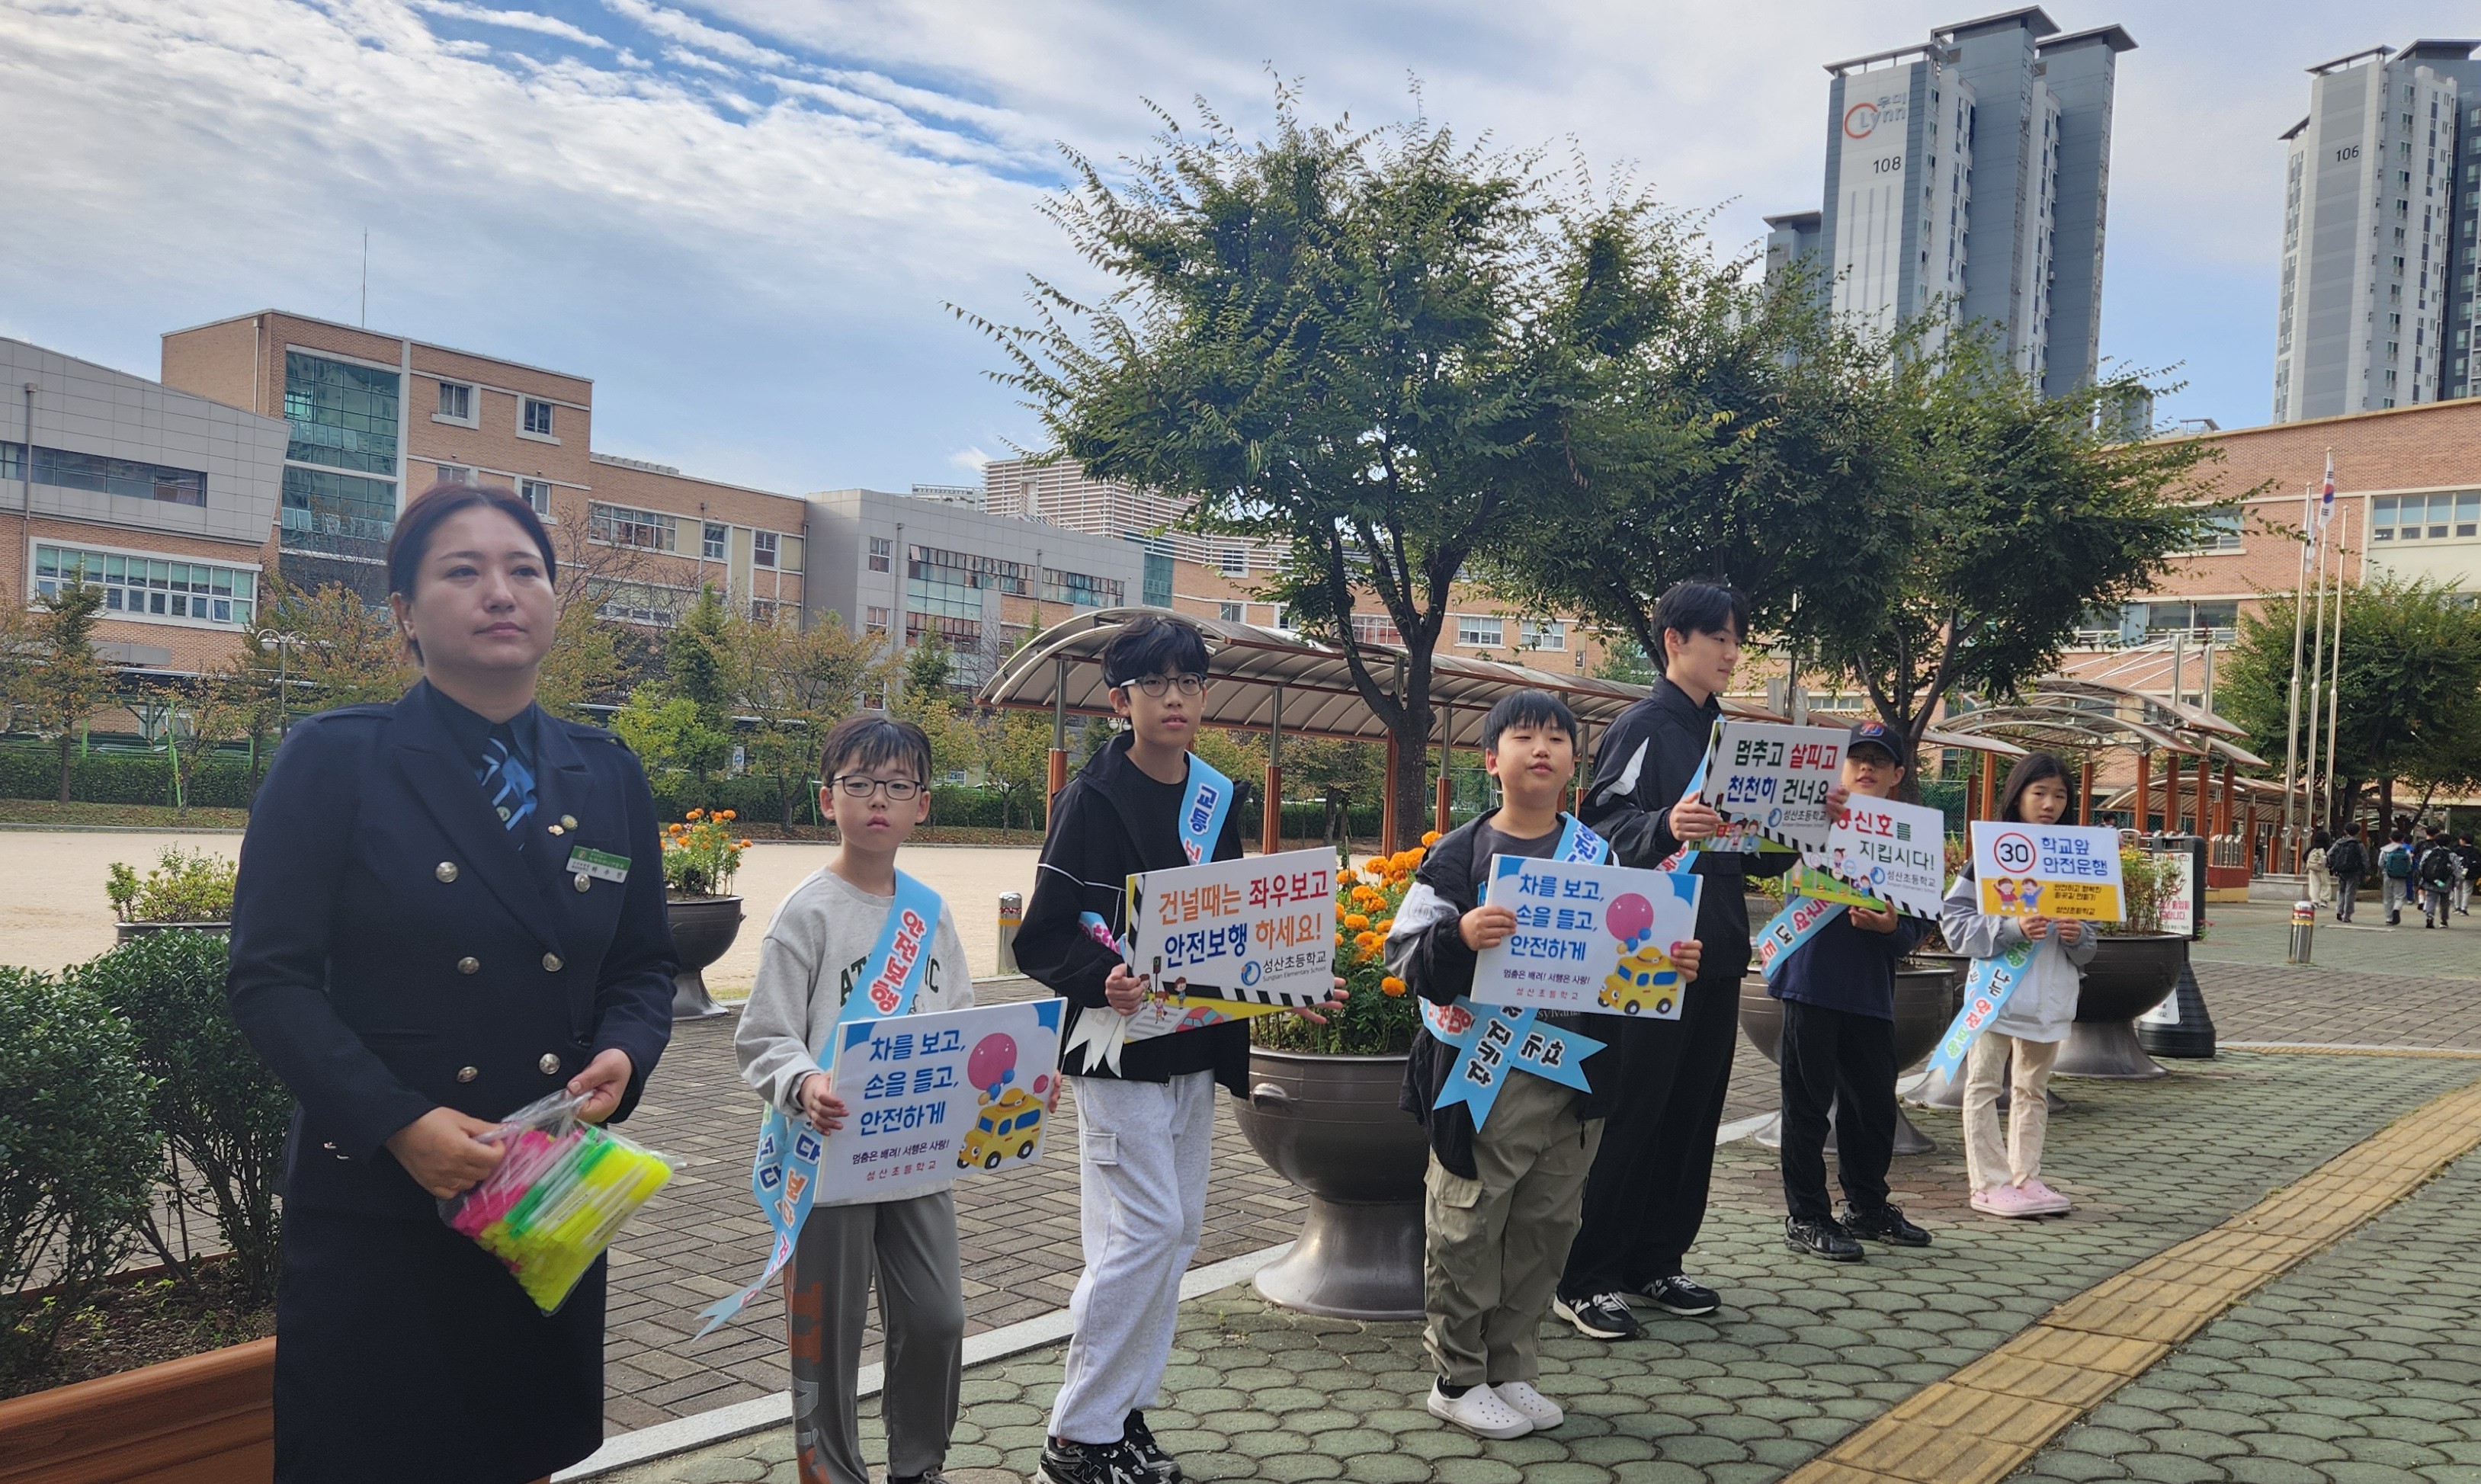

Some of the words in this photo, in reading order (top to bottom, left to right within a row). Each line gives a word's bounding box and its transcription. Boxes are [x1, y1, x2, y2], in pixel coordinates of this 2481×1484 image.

[1877, 91, 1907, 108] 우미
[1861, 107, 1906, 130] Lynn
[1873, 155, 1902, 174] 108
[2336, 145, 2360, 162] 106
[1735, 739, 1785, 768] 멈추고
[1790, 743, 1838, 771] 살피고
[1727, 775, 1777, 804] 천천히
[1782, 778, 1829, 806] 건너요
[1189, 784, 1219, 834] 교통
[1784, 809, 1827, 822] 성산초등학교
[1860, 840, 1934, 871] 지킵시다!
[2000, 843, 2029, 863] 30
[2042, 837, 2090, 855] 학교앞
[1887, 870, 1936, 887] 성산초등학교
[2043, 857, 2108, 877] 안전운행
[1159, 883, 1242, 925] 건널때는
[1249, 870, 1329, 909] 좌우보고
[1518, 873, 1557, 897] 차를
[1563, 879, 1604, 902] 보고,
[1515, 904, 1551, 928] 손을
[1556, 909, 1598, 932] 들고,
[1165, 923, 1248, 969] 안전보행
[1255, 912, 1322, 950] 하세요!
[1510, 934, 1587, 961] 안전하게
[870, 909, 926, 1013] 안전보행
[1263, 950, 1327, 974] 성산초등학교
[1310, 965, 1326, 974] School
[1527, 971, 1547, 982] 배려!
[1547, 973, 1571, 984] 서행은
[1572, 975, 1591, 986] 사랑!
[869, 1034, 913, 1062] 차를
[919, 1030, 966, 1056] 보고,
[864, 1071, 906, 1100] 손을
[913, 1066, 959, 1094] 들고,
[860, 1101, 946, 1136] 안전하게
[880, 1146, 902, 1159] 배려!
[902, 1141, 928, 1157] 서행은
[929, 1139, 950, 1152] 사랑!
